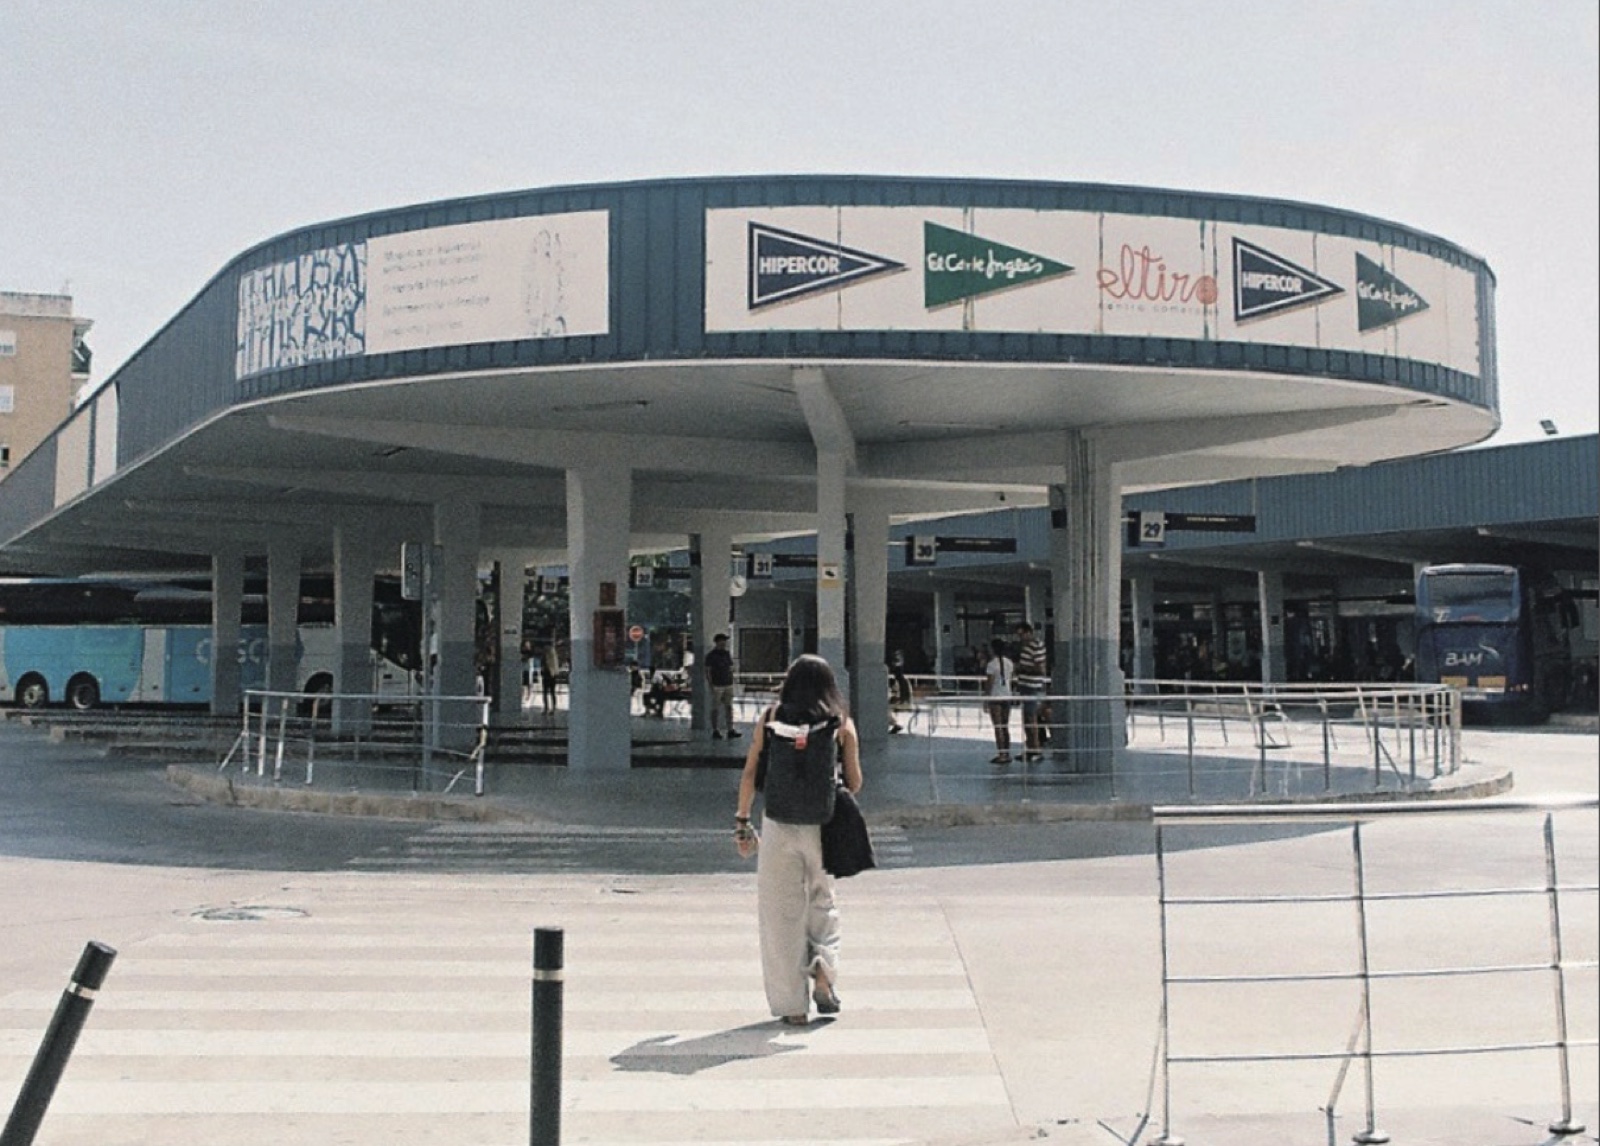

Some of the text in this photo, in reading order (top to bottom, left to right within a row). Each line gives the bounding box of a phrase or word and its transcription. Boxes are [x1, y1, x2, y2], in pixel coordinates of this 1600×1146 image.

[759, 256, 840, 275] HIPERCOR
[928, 252, 945, 272] El
[1241, 271, 1303, 293] HIPERCOR
[1144, 522, 1161, 538] 29
[757, 561, 769, 573] 31
[1445, 652, 1484, 667] BAM
